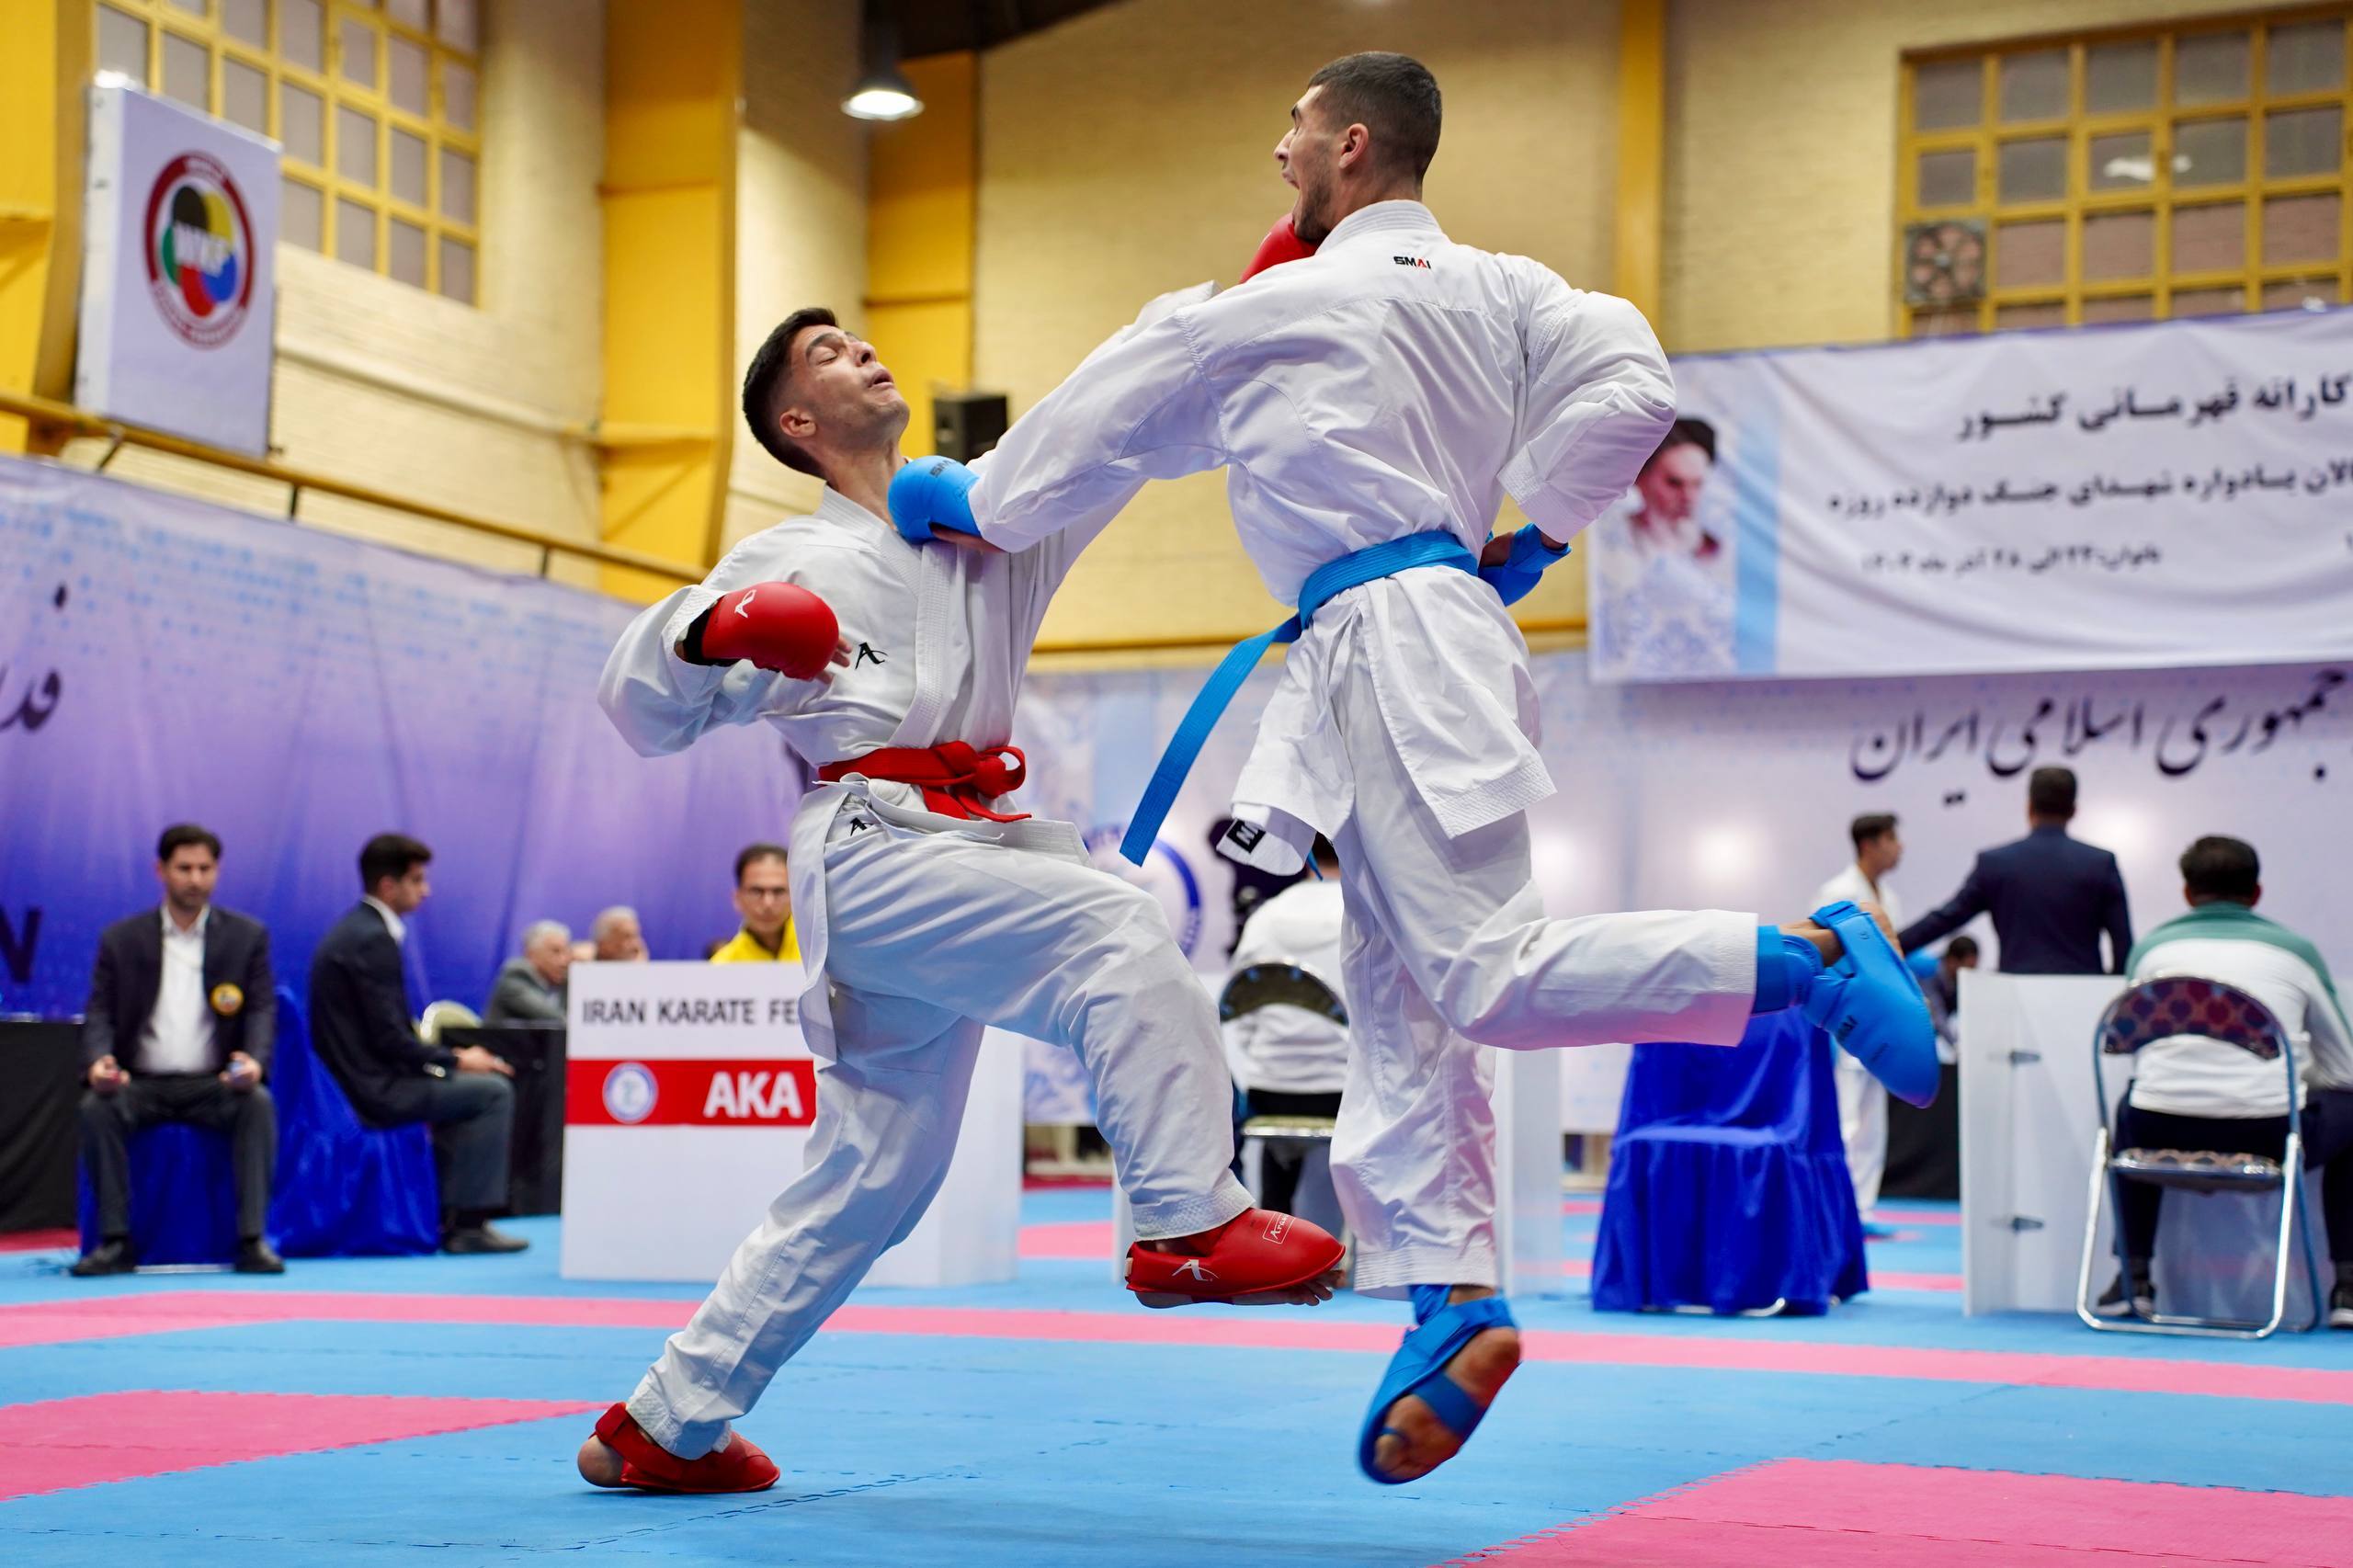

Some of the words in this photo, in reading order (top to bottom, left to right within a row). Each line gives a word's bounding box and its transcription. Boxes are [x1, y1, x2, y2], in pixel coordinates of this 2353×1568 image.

[1392, 256, 1431, 269] SMAI
[1957, 391, 2068, 442] کشور
[2077, 380, 2240, 431] قهرمانی
[2254, 373, 2352, 420] کاراته
[1986, 696, 2145, 778] اسلامی
[2155, 666, 2349, 780] جمهوری
[1849, 709, 1980, 807] ایران
[583, 999, 646, 1024] IRAN
[657, 999, 756, 1025] KARATE
[768, 999, 800, 1025] FE
[703, 1072, 803, 1119] AKA
